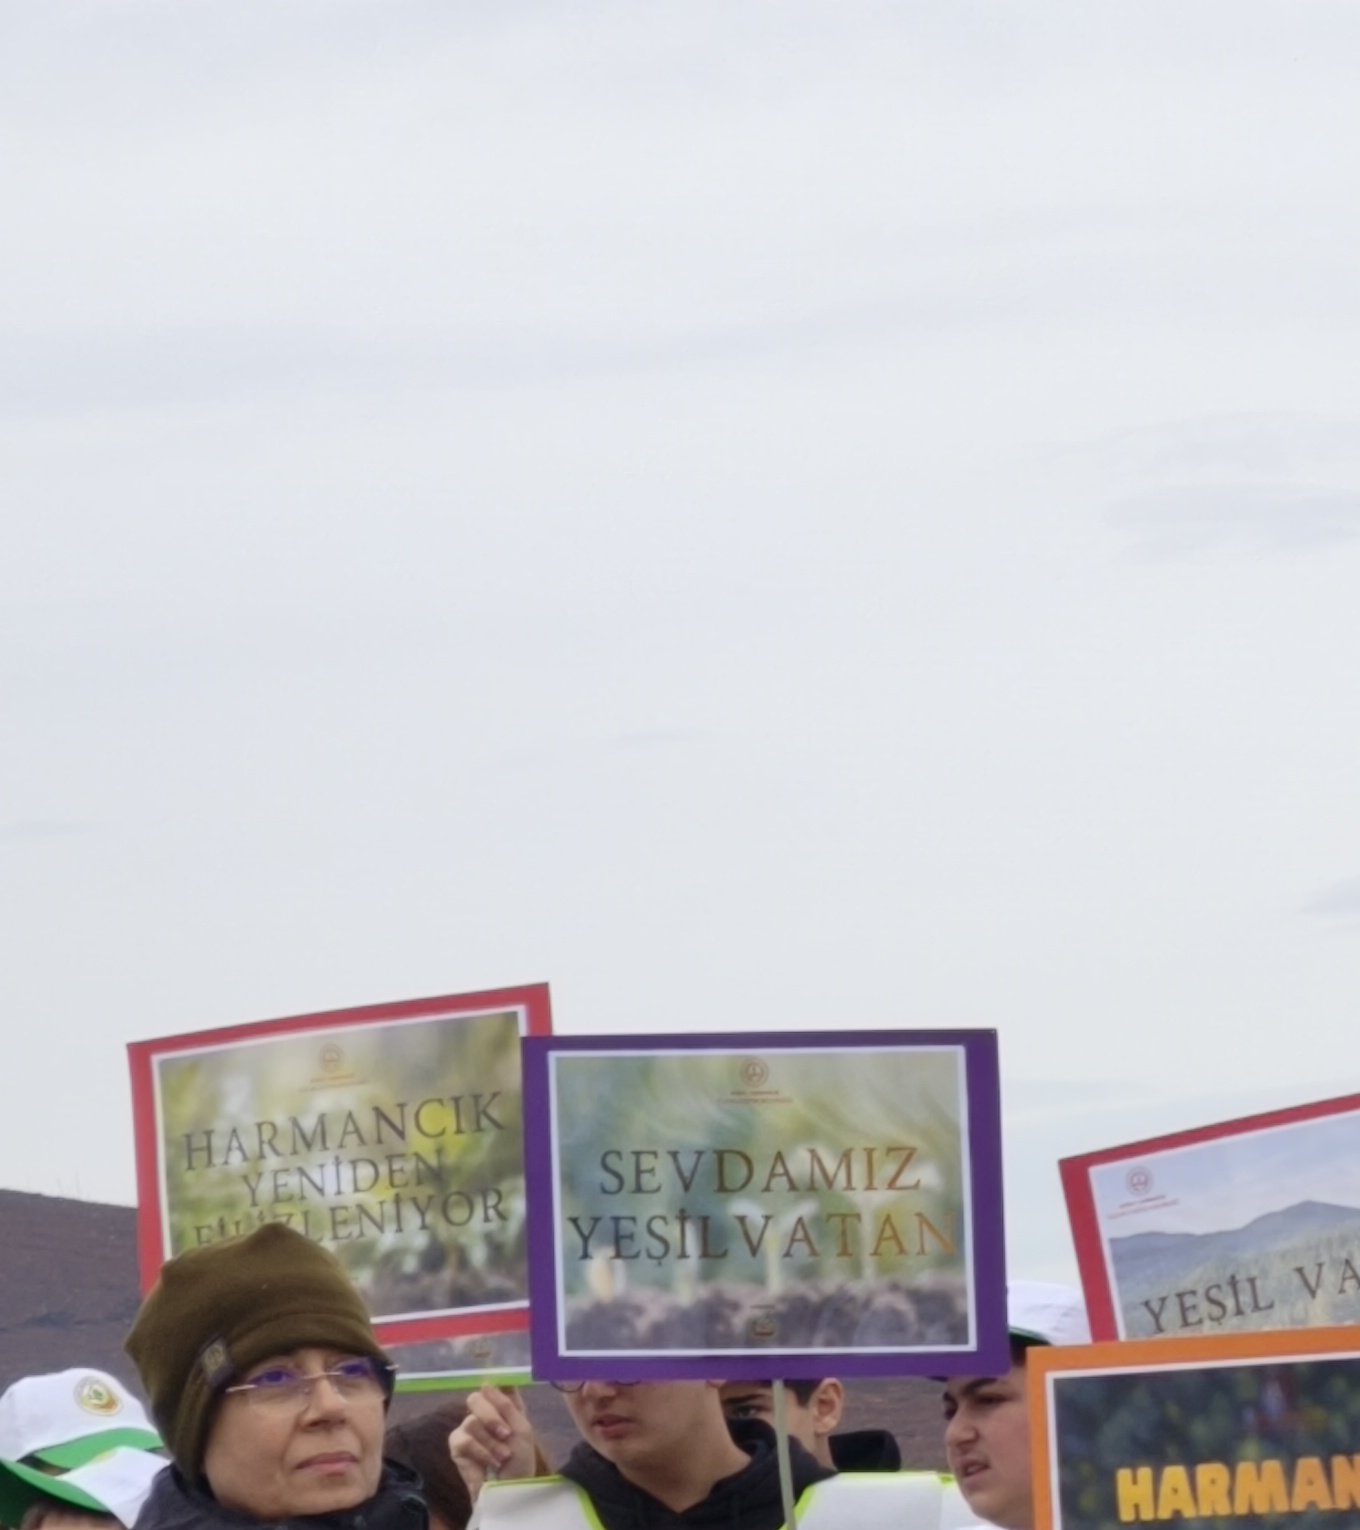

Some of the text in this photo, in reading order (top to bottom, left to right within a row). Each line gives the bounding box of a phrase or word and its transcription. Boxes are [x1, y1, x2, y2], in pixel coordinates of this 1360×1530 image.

[183, 1092, 507, 1171] HARMANCIK
[243, 1147, 445, 1207] YENİDEN
[600, 1147, 921, 1195] SEVDAMIZ
[1143, 1272, 1275, 1336] YEŞİL
